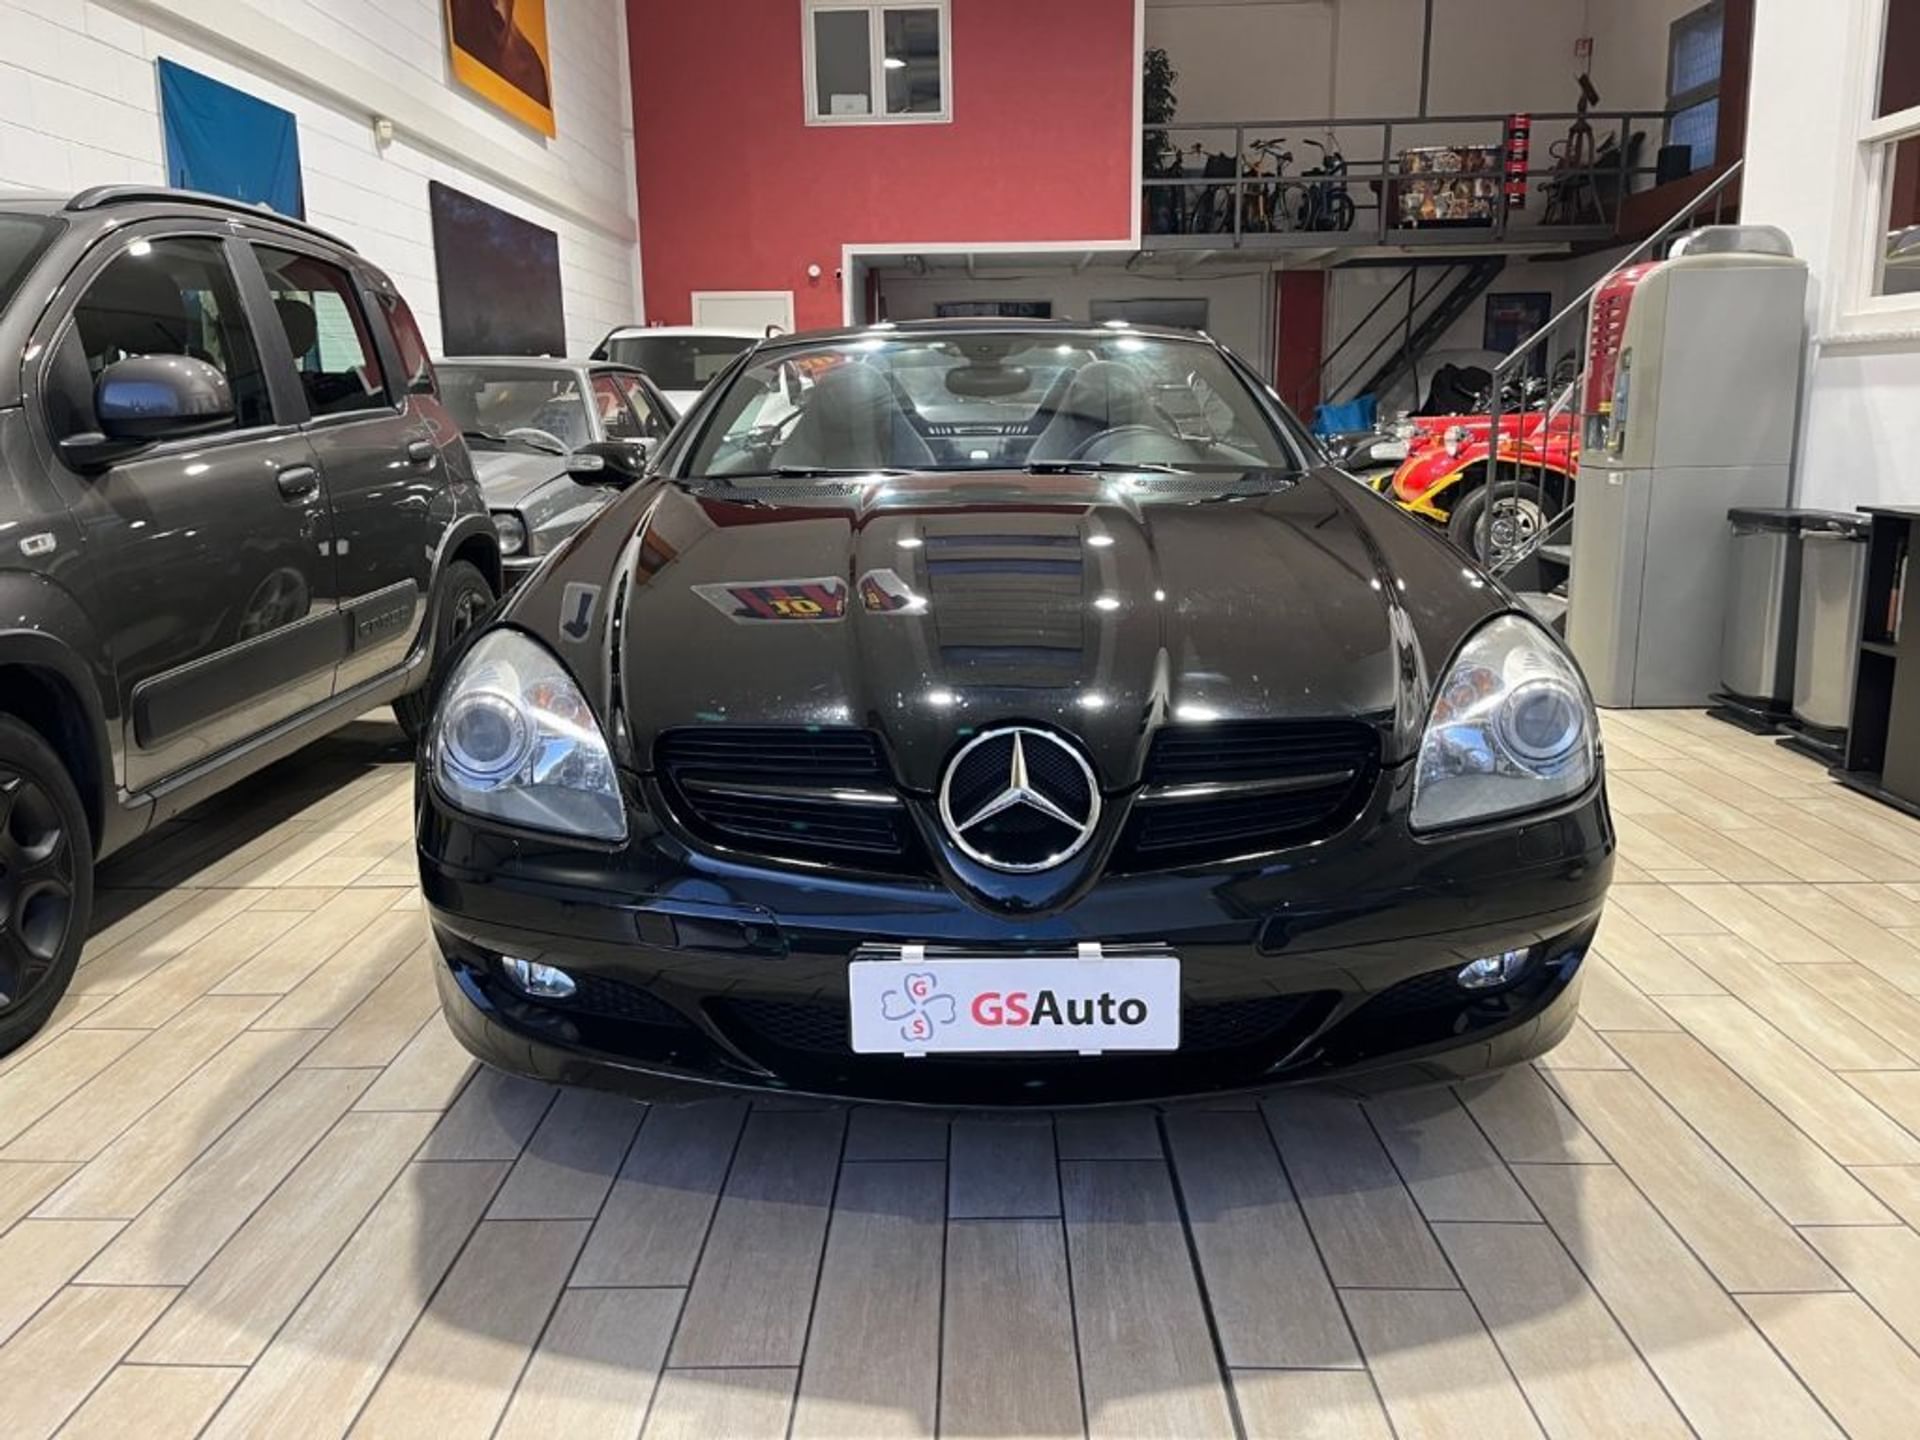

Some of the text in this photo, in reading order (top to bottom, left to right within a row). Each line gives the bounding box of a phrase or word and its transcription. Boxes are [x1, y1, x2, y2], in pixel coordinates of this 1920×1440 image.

[912, 981, 927, 997] G
[971, 990, 1148, 1027] GSAuto
[913, 1020, 924, 1035] S
